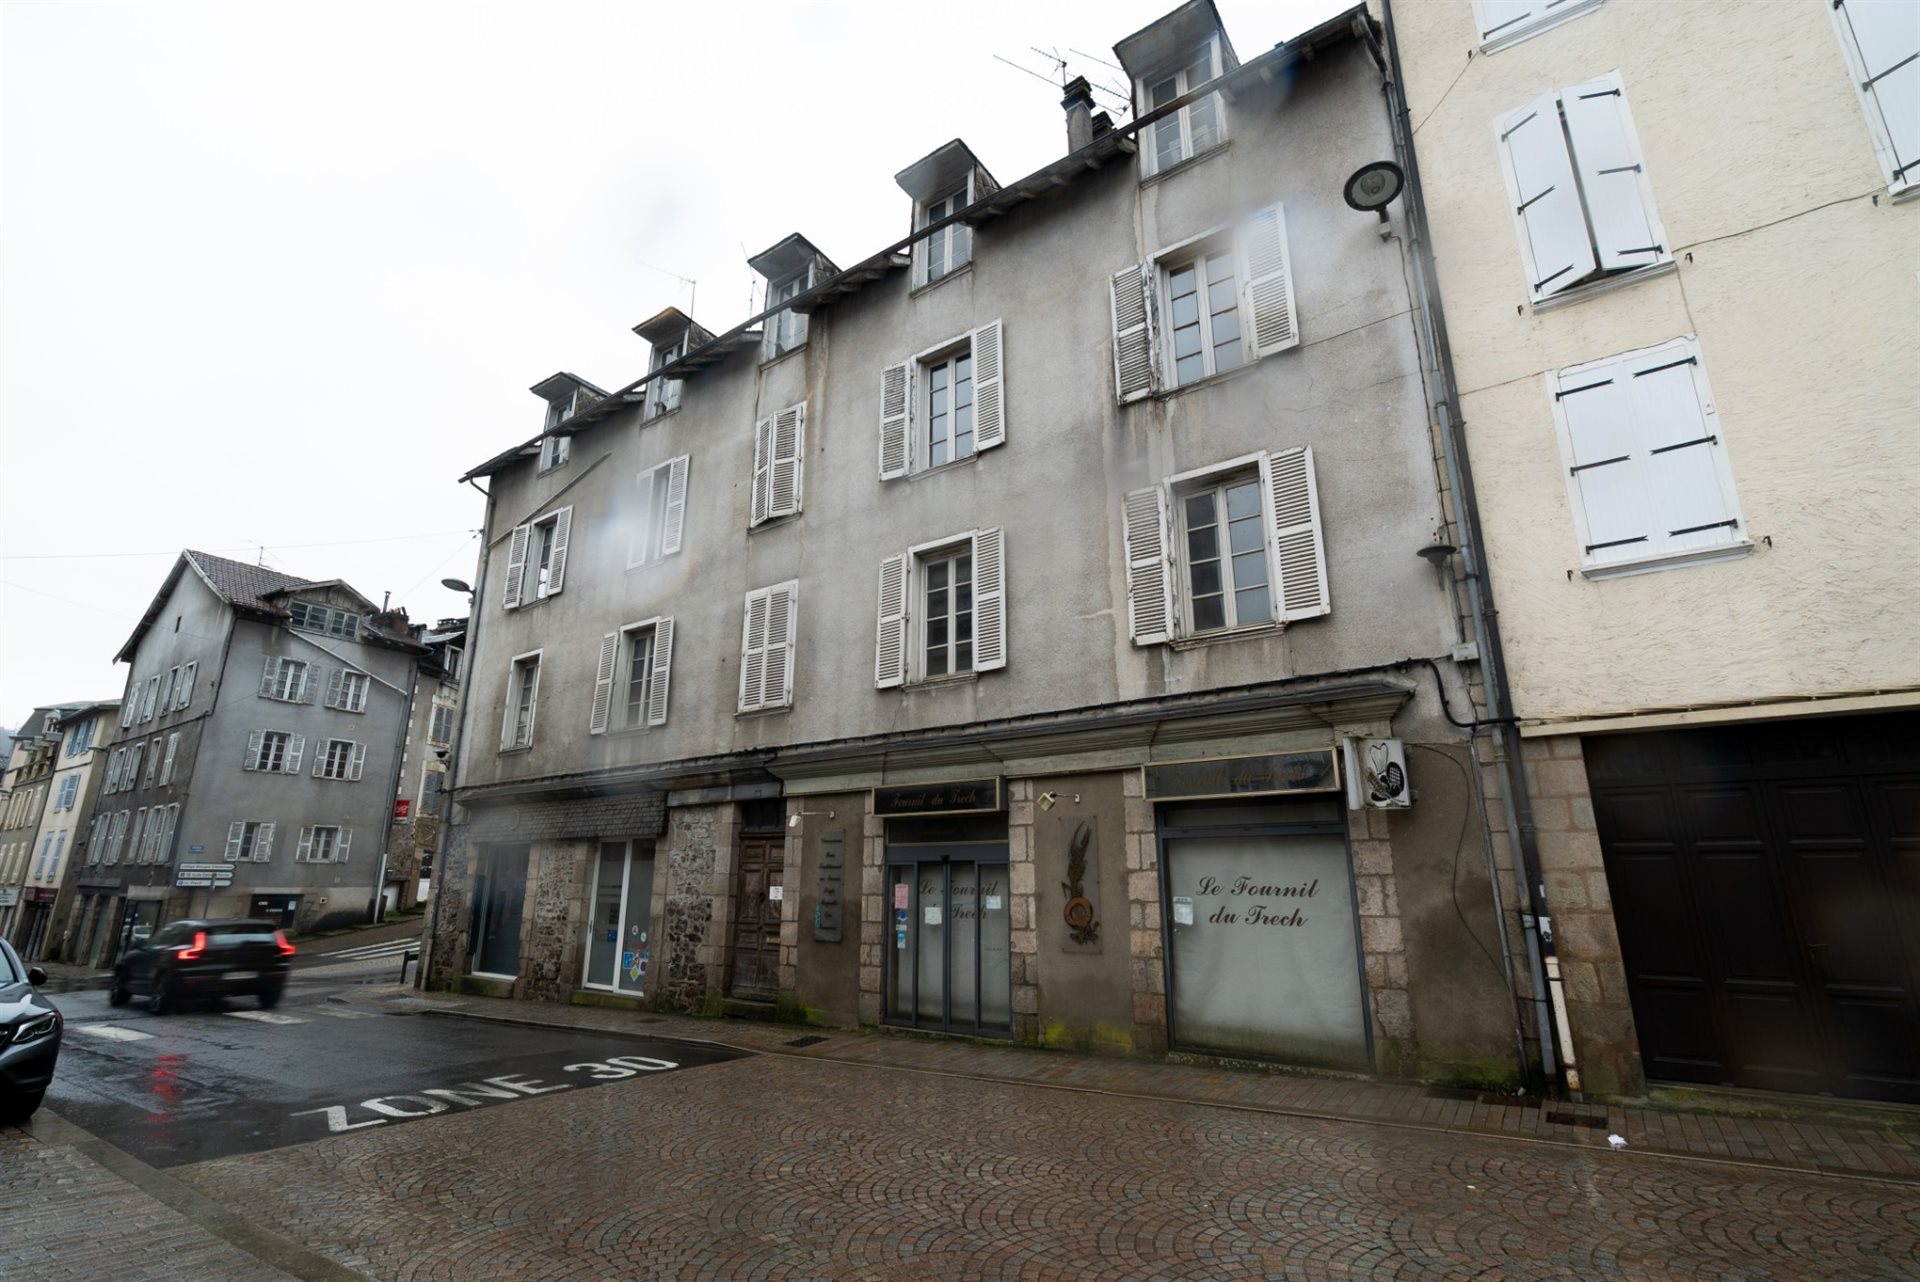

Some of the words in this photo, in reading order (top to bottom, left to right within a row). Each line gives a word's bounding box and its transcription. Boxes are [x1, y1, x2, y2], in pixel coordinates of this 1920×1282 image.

[931, 794, 943, 805] du
[920, 880, 934, 895] Le
[940, 880, 998, 896] ouril
[1196, 876, 1224, 896] Le
[1230, 876, 1319, 898] Fournil
[1209, 906, 1240, 924] du
[1245, 905, 1308, 927] Trech
[291, 1073, 574, 1131] ZONE
[563, 1056, 679, 1079] 30
